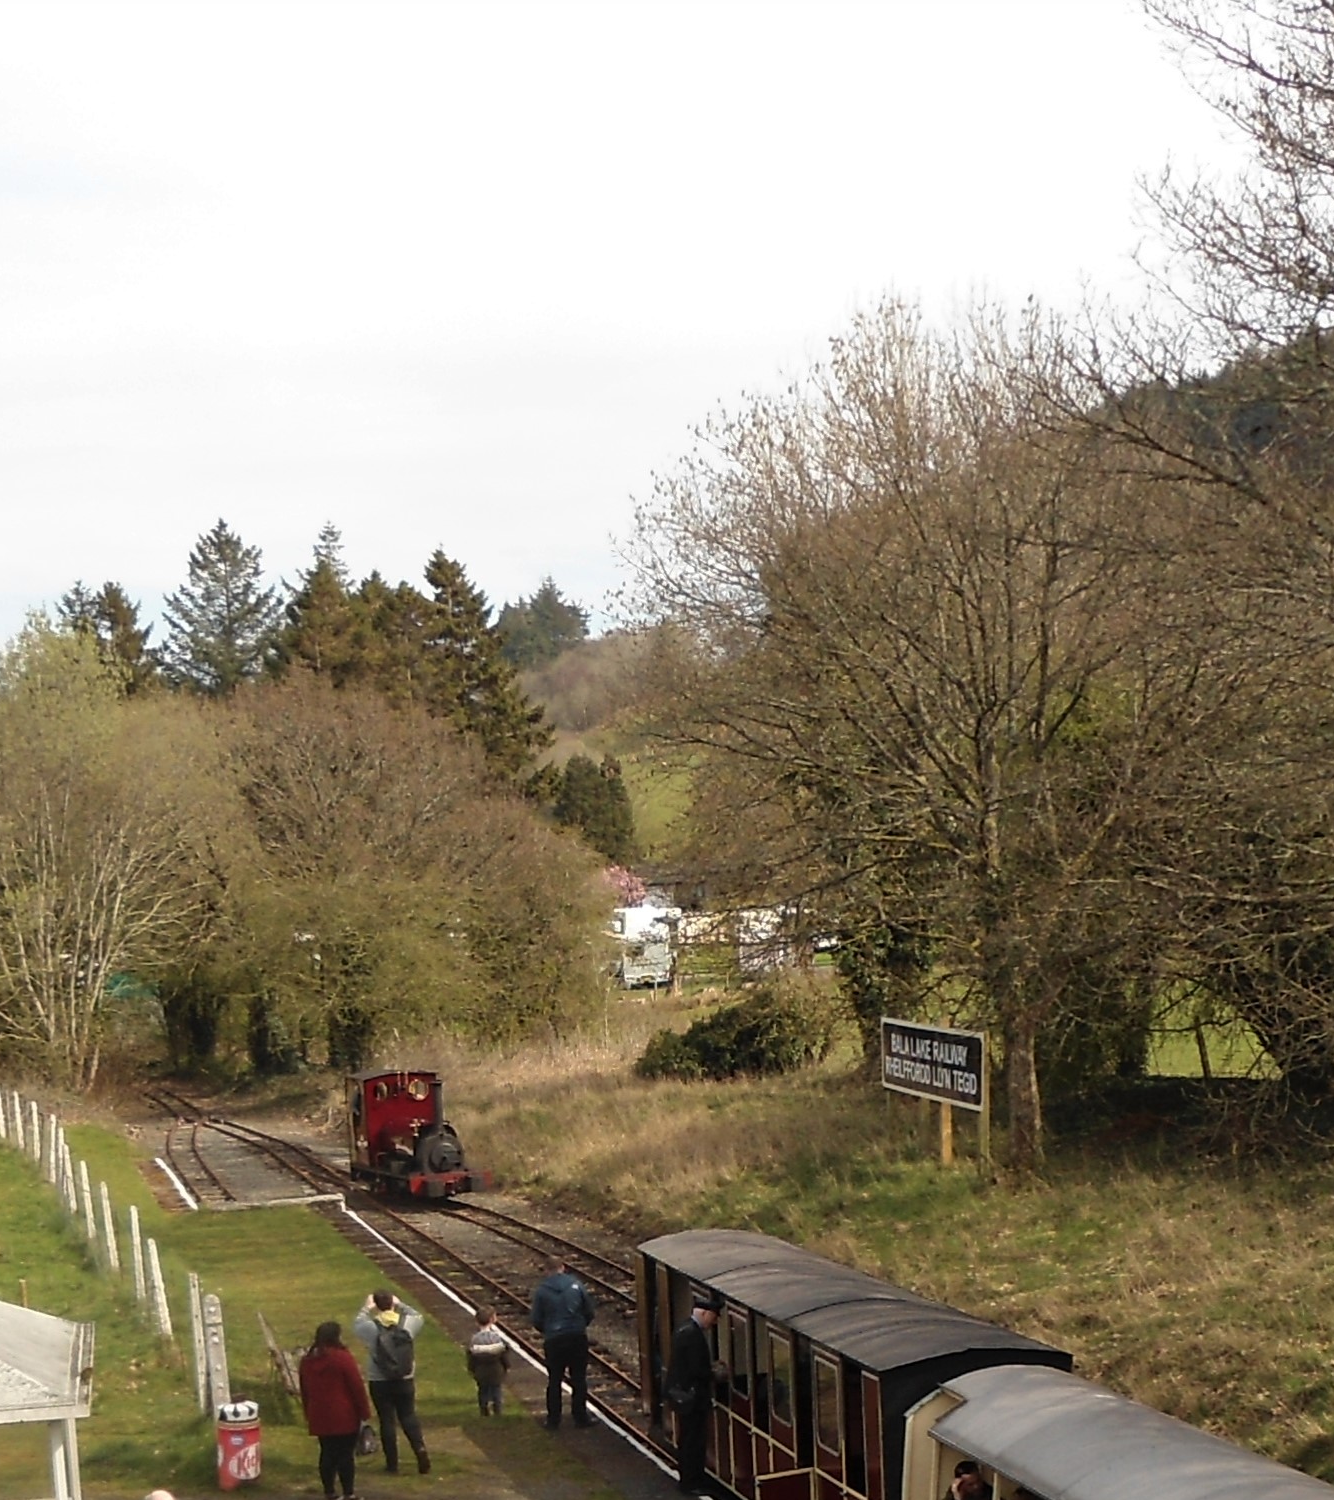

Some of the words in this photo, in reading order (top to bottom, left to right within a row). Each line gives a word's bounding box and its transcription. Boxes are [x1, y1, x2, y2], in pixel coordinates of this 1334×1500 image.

[891, 1033, 910, 1055] BALA
[910, 1037, 931, 1060] LAKE
[933, 1041, 968, 1067] RAILWAY
[952, 1070, 977, 1095] TEGID
